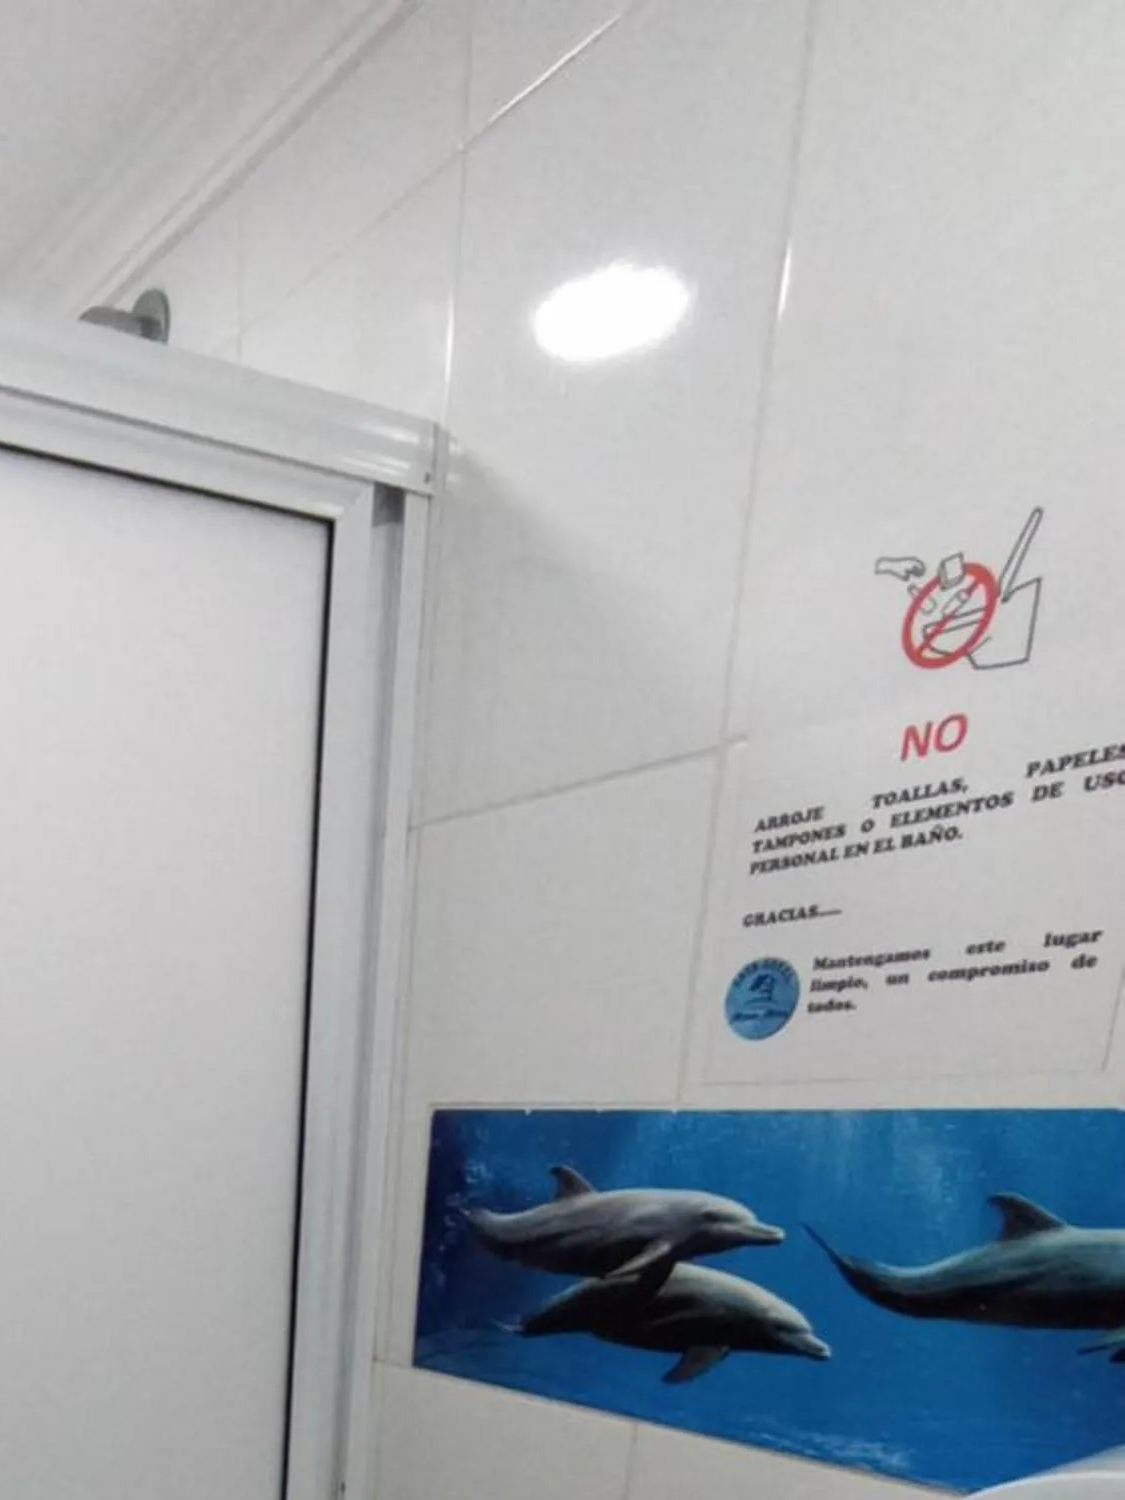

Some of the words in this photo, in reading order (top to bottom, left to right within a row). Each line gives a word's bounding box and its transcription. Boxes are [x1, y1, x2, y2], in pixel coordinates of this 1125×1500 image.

[901, 713, 969, 762] NO
[752, 823, 846, 853] TAMPONES
[860, 818, 875, 834] O
[890, 791, 1014, 829] ELEMENTOS
[1031, 781, 1065, 803] DE
[754, 805, 824, 833] ARROJE
[872, 777, 969, 809] TOALLAS,
[749, 847, 839, 875] PERSONAL
[842, 841, 870, 860] EN
[873, 836, 896, 854] EL
[900, 823, 964, 849] BAÑO.
[810, 974, 869, 993] limpio,
[885, 972, 910, 987] un
[927, 958, 1051, 983] compromiso
[1071, 952, 1099, 970] de
[813, 948, 931, 971] Mantengamos
[965, 939, 1007, 956] este
[1042, 929, 1104, 950] lugar
[806, 998, 857, 1014] todos.
